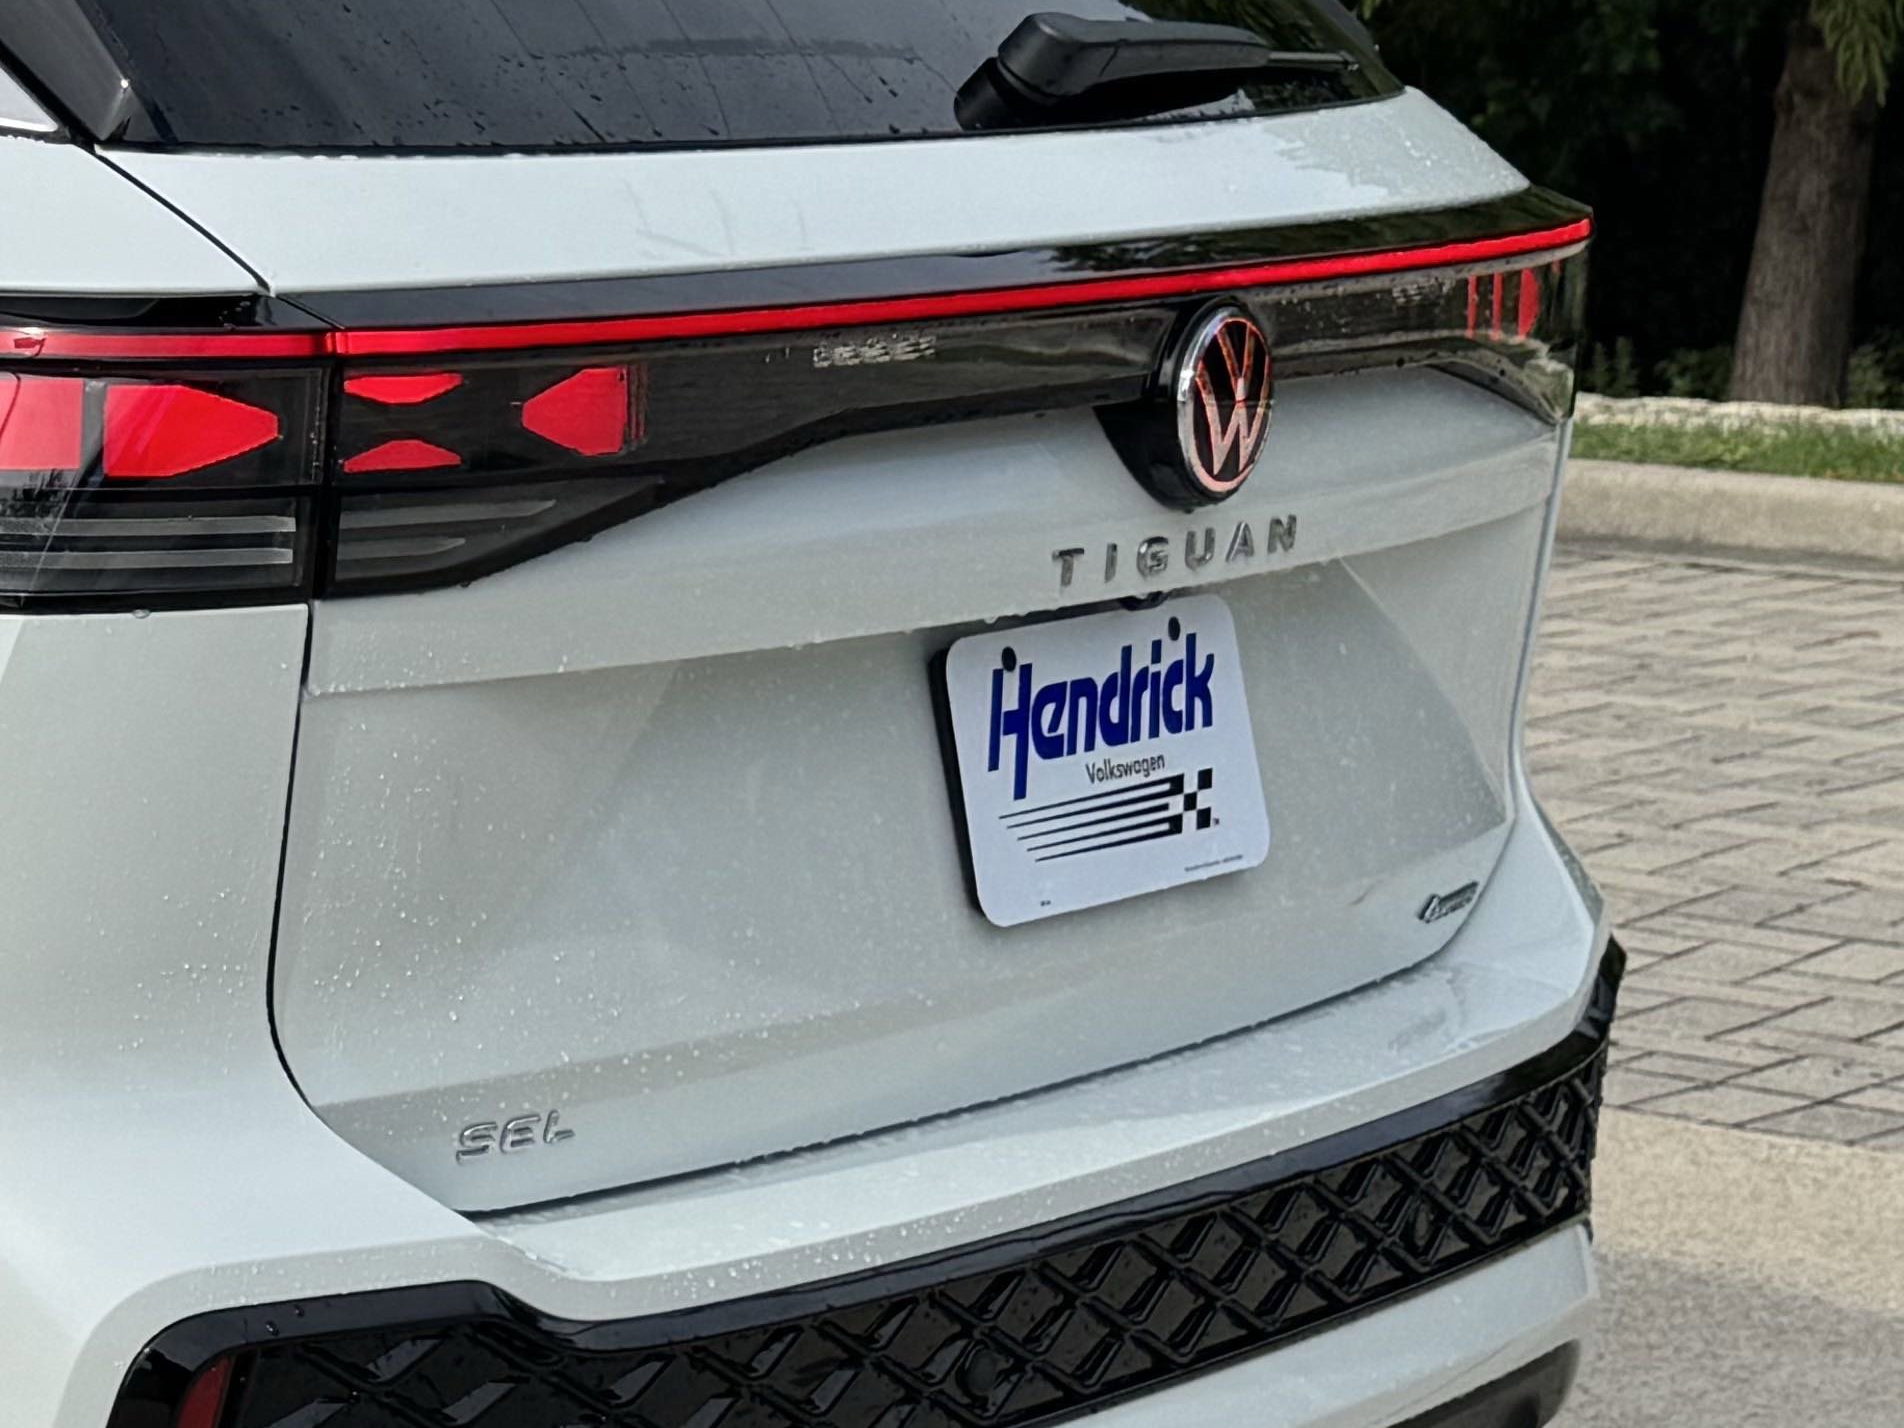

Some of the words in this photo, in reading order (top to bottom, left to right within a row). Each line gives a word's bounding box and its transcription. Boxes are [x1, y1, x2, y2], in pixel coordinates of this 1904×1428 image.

[1051, 513, 1298, 588] TIGUAN
[987, 632, 1215, 801] Hendrick
[1085, 753, 1166, 785] Volkswagen
[455, 1109, 576, 1165] SEL
